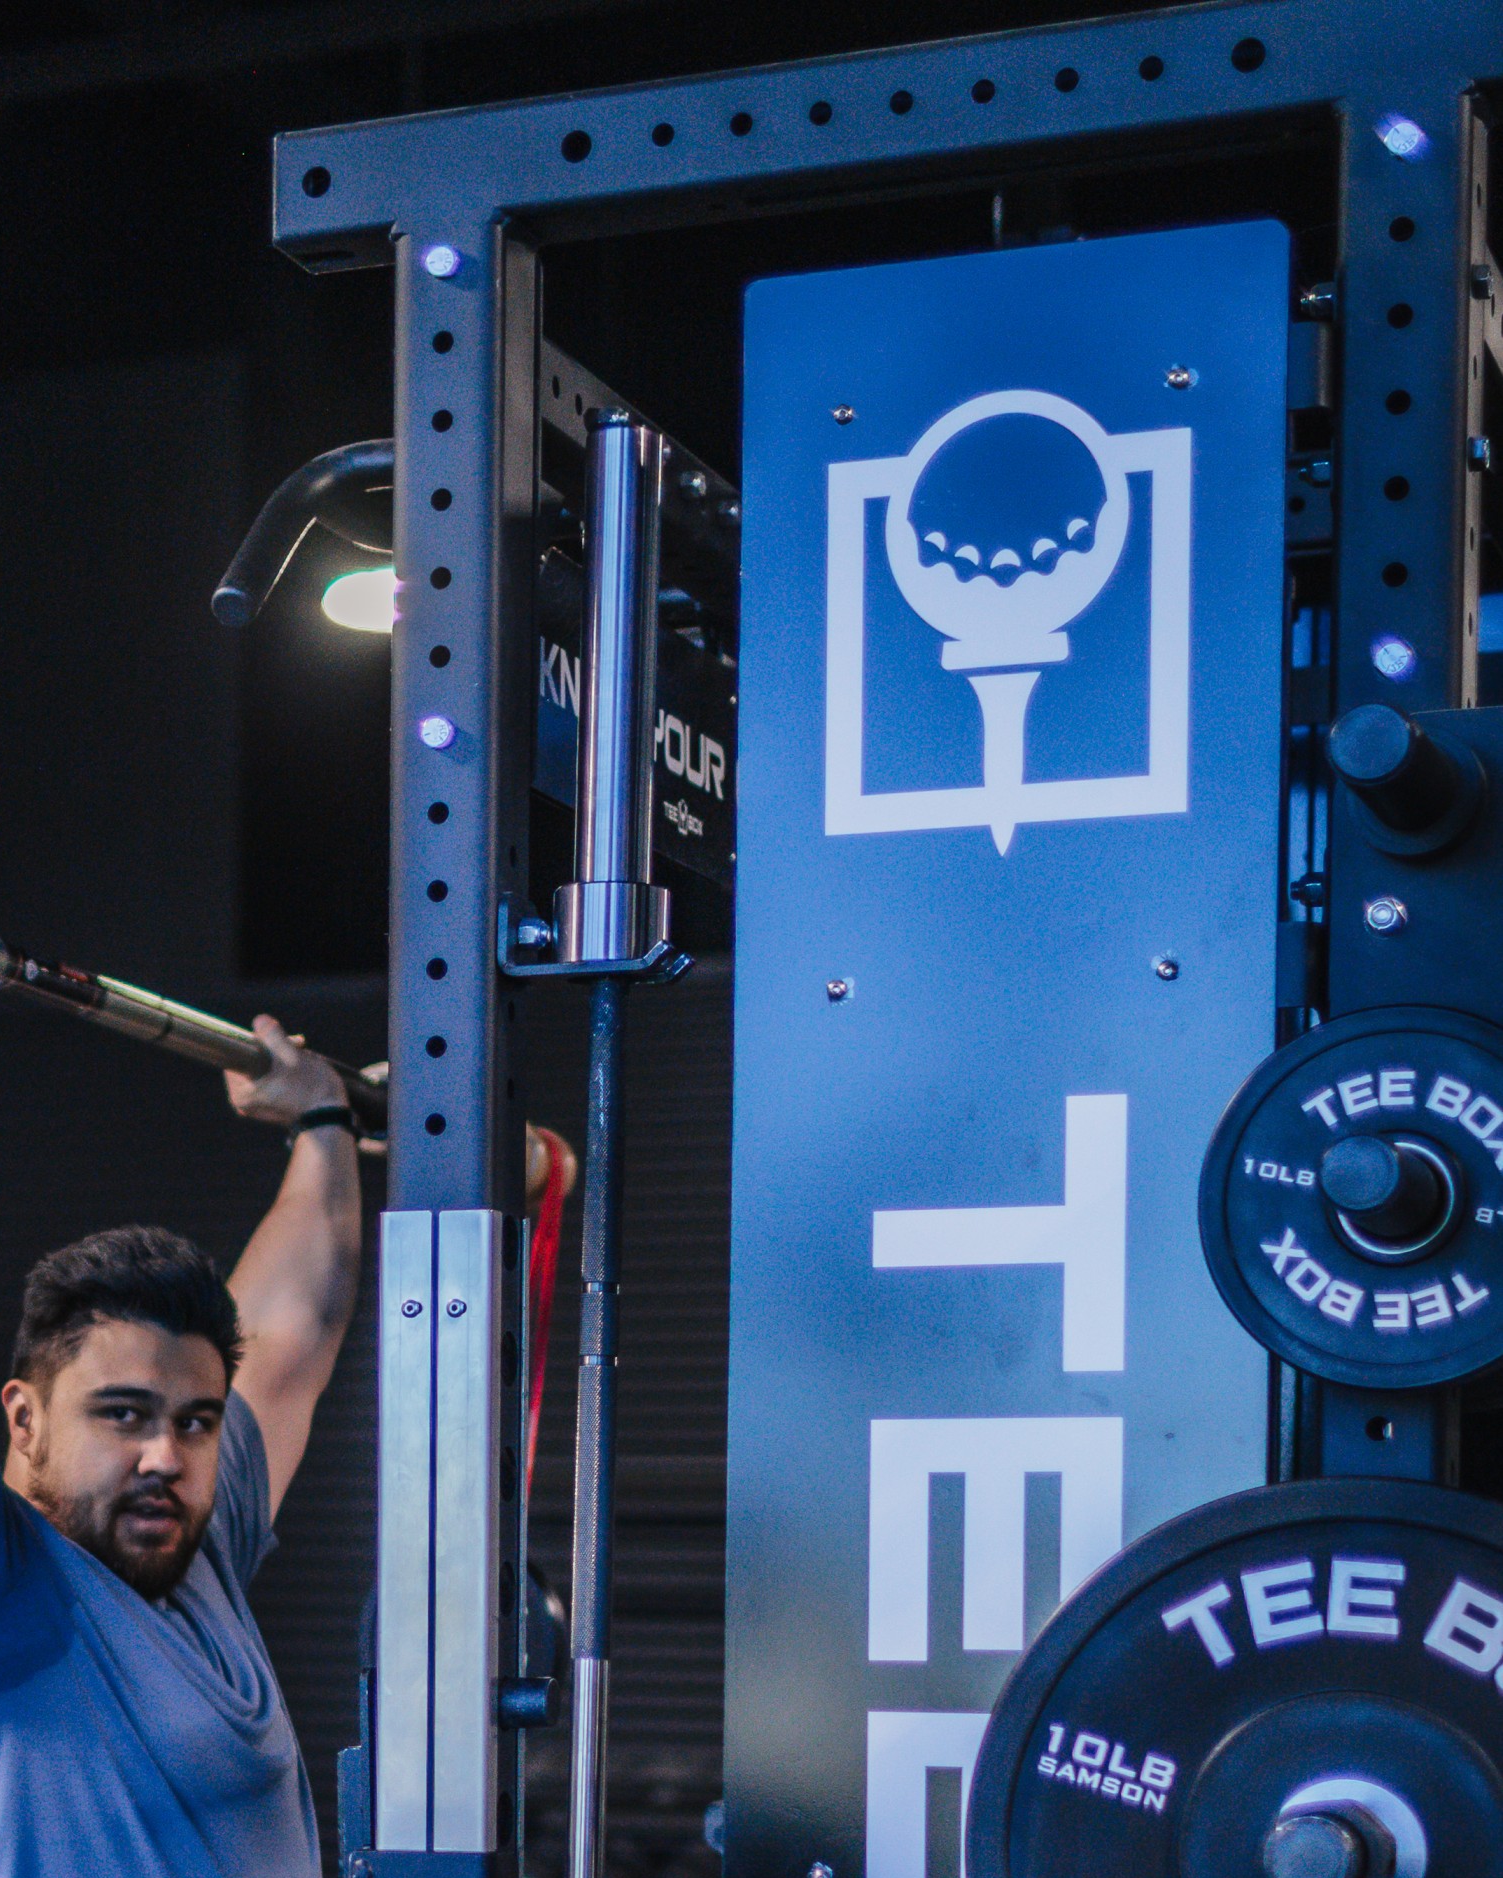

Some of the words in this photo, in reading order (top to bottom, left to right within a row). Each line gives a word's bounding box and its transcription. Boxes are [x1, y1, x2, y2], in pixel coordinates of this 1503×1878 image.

[1301, 1070, 1416, 1128] TEE
[1243, 1158, 1316, 1187] 10LB
[1260, 1227, 1364, 1323] BOX
[1372, 1273, 1490, 1328] TEE
[1161, 1559, 1405, 1667] TEE
[1037, 1755, 1166, 1810] SAMSON
[1048, 1724, 1176, 1789] 10LB
